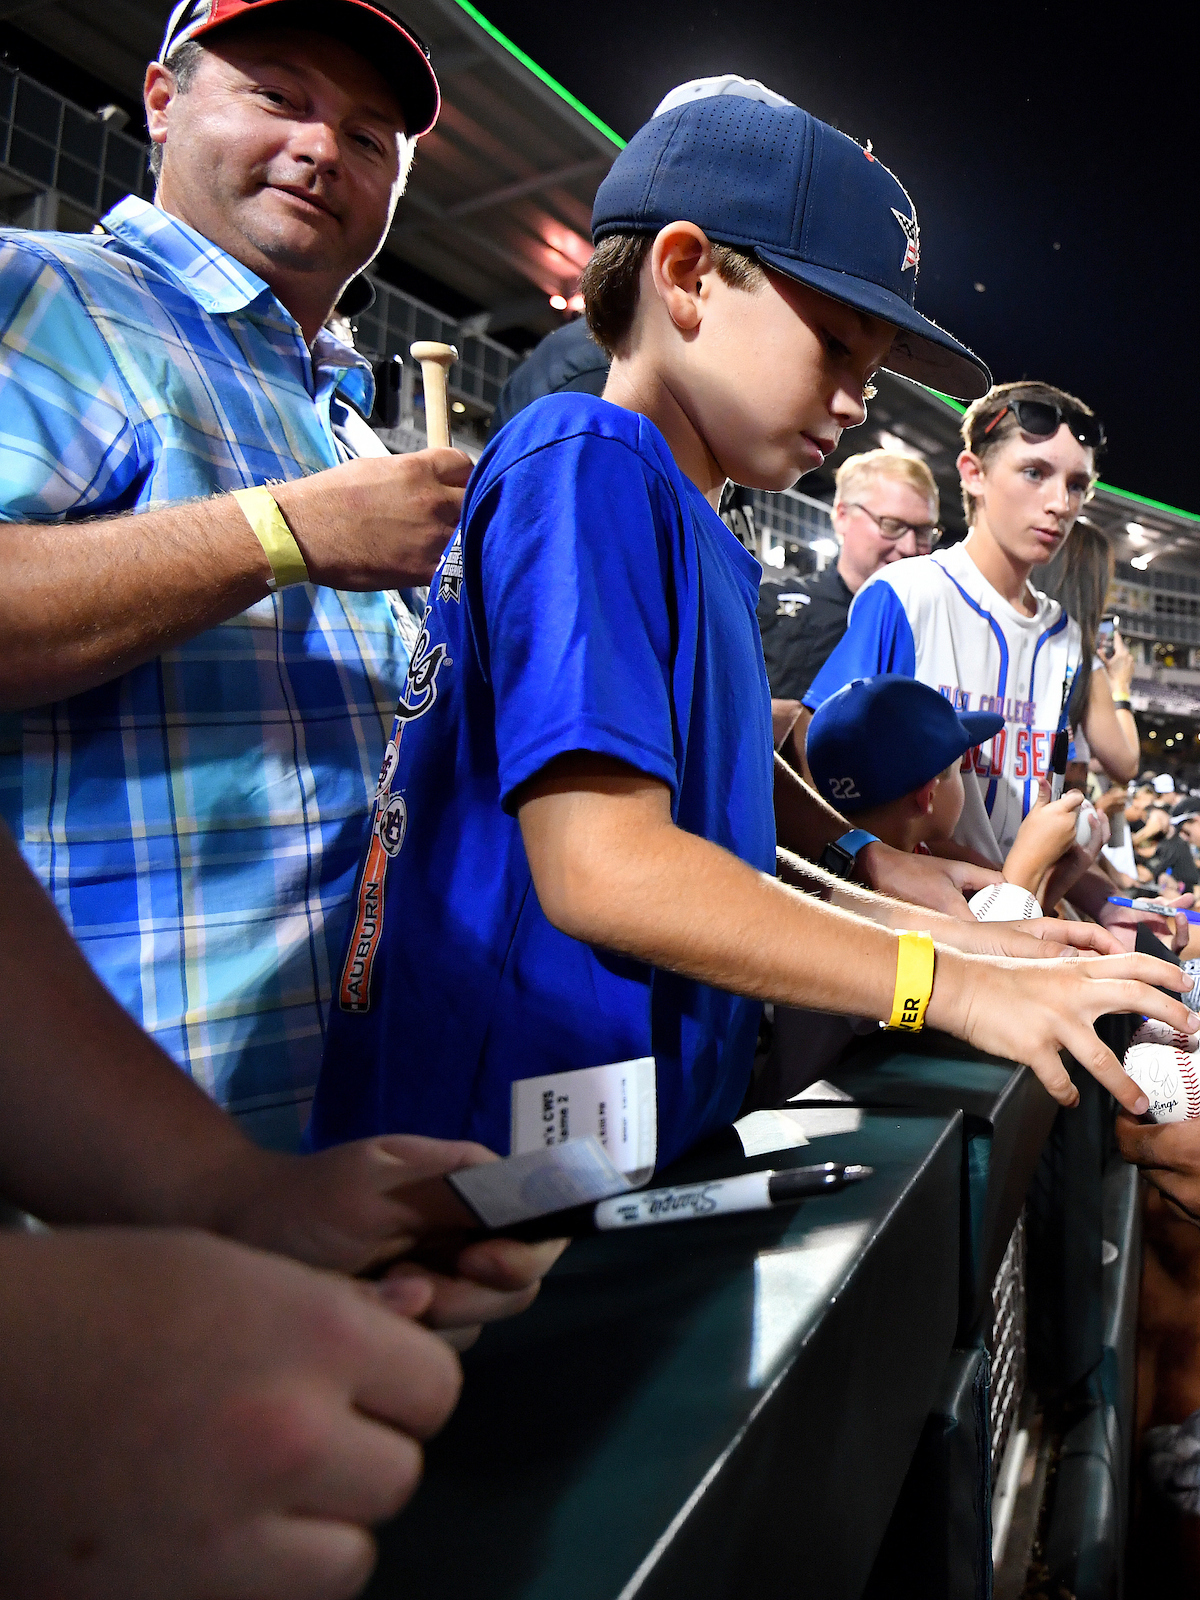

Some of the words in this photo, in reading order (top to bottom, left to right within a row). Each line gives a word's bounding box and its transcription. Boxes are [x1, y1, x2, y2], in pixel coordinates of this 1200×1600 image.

[828, 777, 861, 799] 22
[346, 881, 381, 1000] AUBURN
[900, 998, 921, 1030] ER
